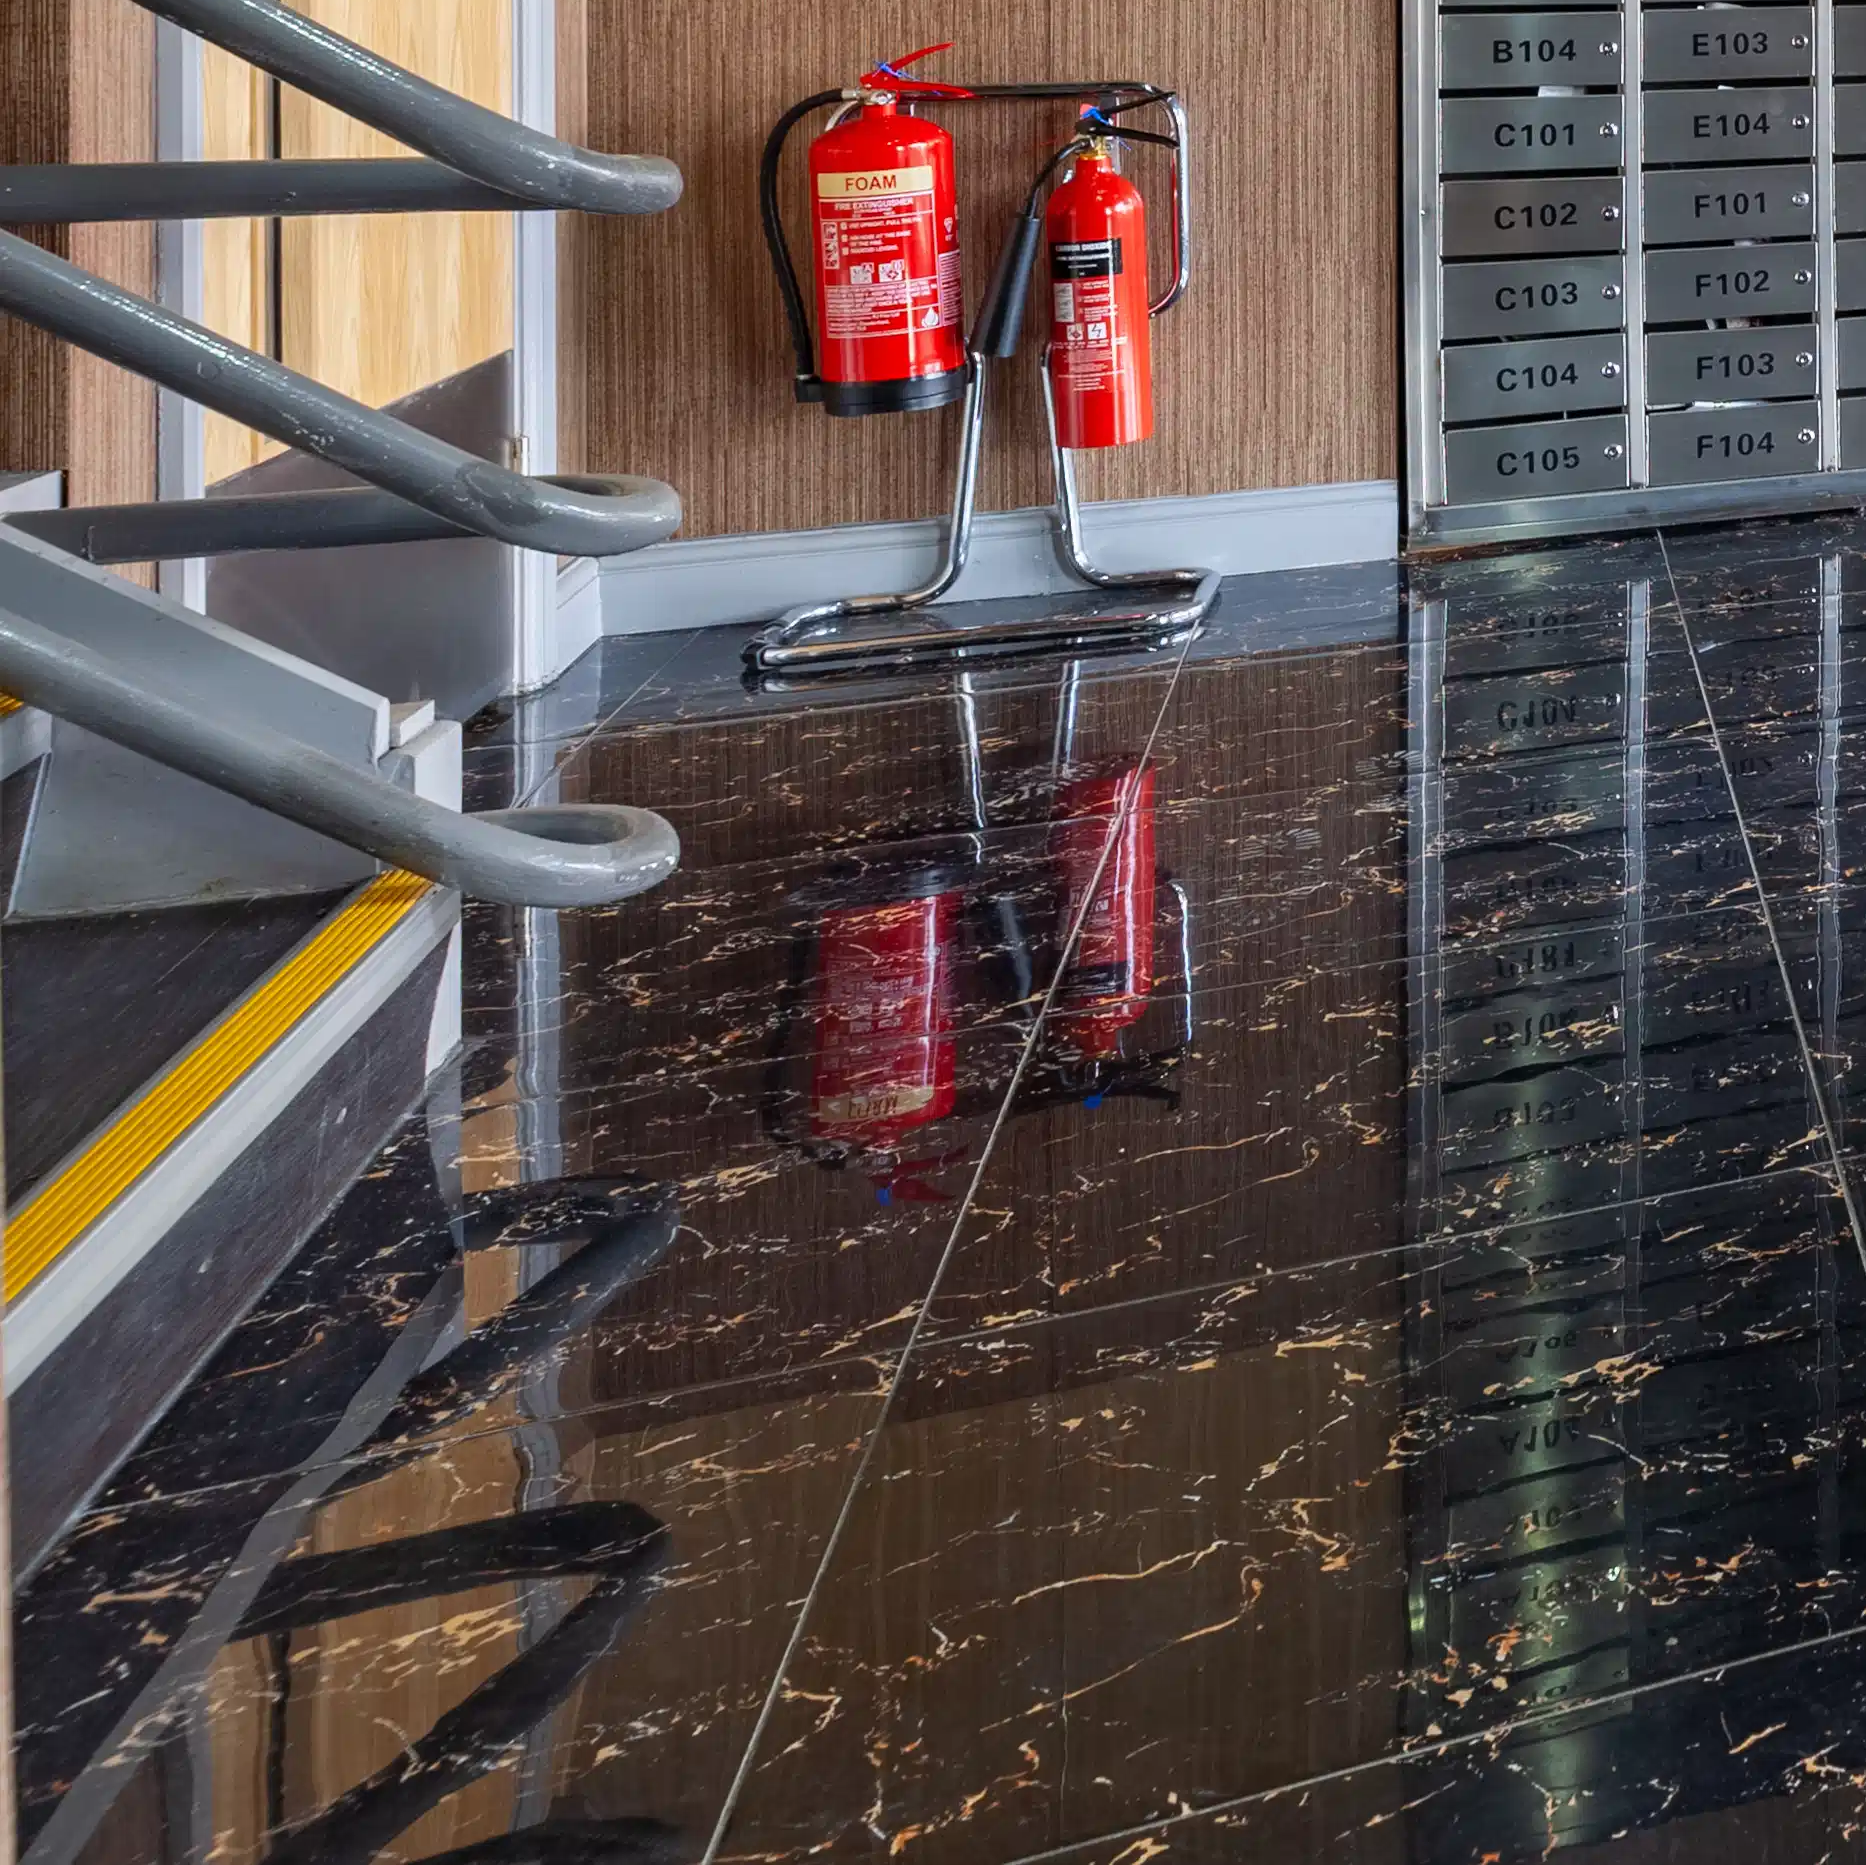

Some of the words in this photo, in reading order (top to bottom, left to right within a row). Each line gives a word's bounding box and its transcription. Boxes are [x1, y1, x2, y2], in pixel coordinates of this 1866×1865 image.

[1492, 38, 1577, 64] B104
[1691, 31, 1769, 57] E103
[1494, 122, 1575, 148] C101
[1693, 112, 1771, 139] E104
[845, 174, 897, 192] FOAM
[1493, 202, 1578, 231] C102
[1694, 191, 1766, 219] F101
[1494, 281, 1579, 311] C103
[1695, 269, 1770, 298] F102
[1495, 362, 1579, 392] C104
[1696, 352, 1775, 381] F103
[1696, 431, 1775, 459] F104
[1496, 445, 1580, 477] C105
